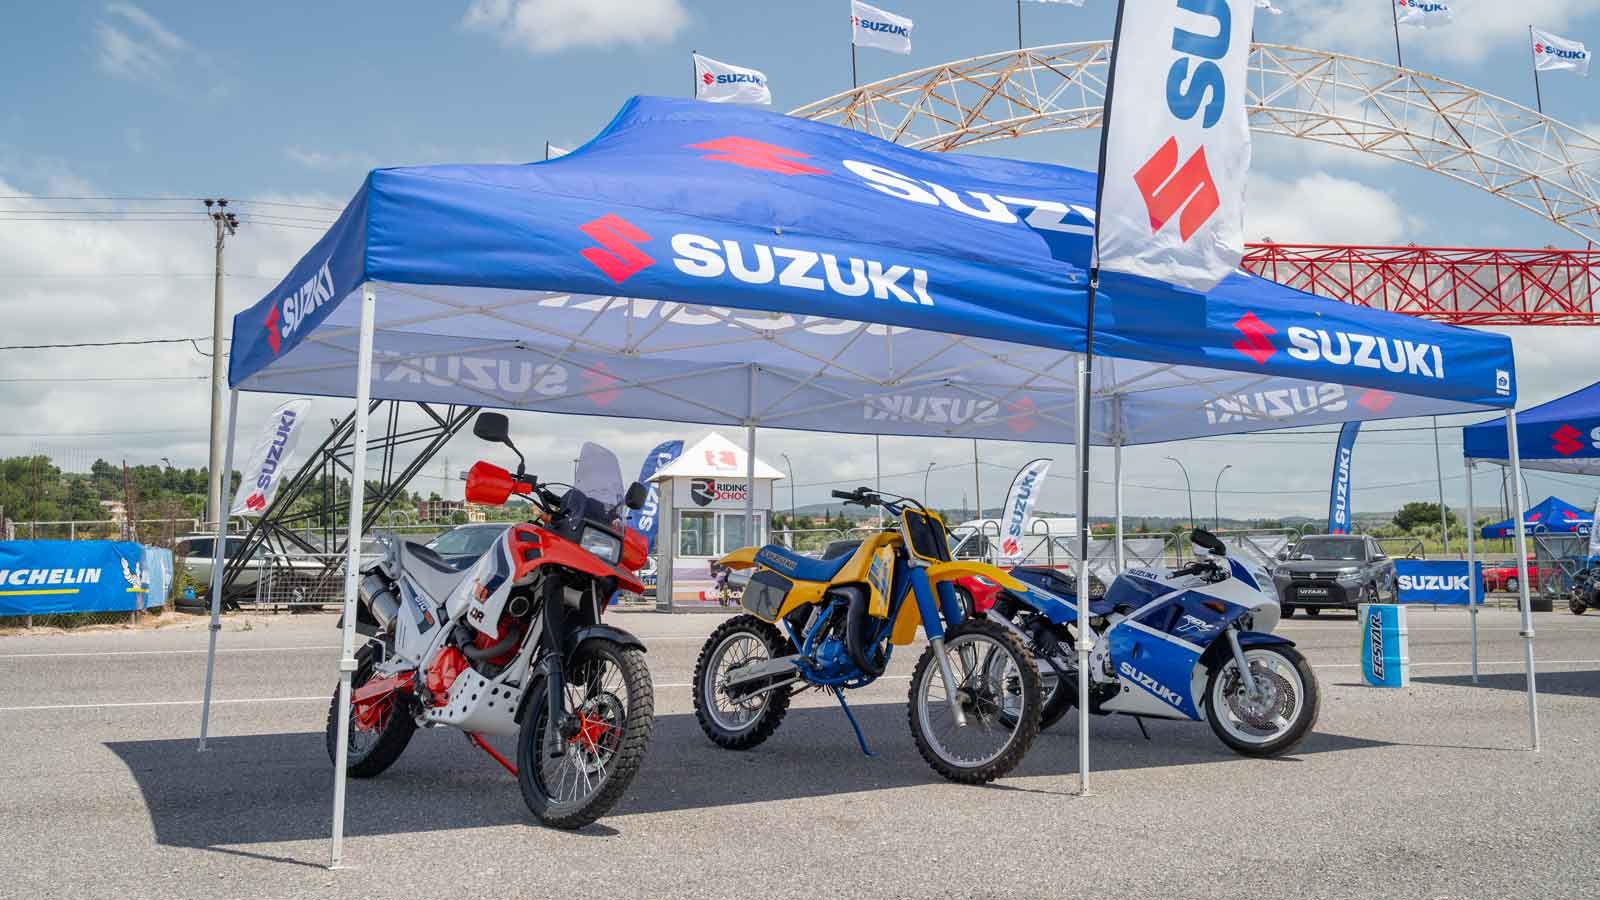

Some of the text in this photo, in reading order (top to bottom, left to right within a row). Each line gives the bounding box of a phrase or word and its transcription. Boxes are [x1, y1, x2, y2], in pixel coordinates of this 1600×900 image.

[1545, 45, 1586, 59] SUZUKI
[671, 233, 935, 306] SUZUKI
[282, 262, 335, 338] SUZKI
[1287, 326, 1444, 379] SUZUKI
[257, 409, 297, 490] SUZUKI
[1009, 470, 1038, 537] SUZUKI
[1335, 448, 1350, 524] SUZUKI
[0, 568, 101, 585] ICHELIN
[1398, 575, 1470, 591] SUZUK
[1120, 661, 1183, 706] SUZUKI
